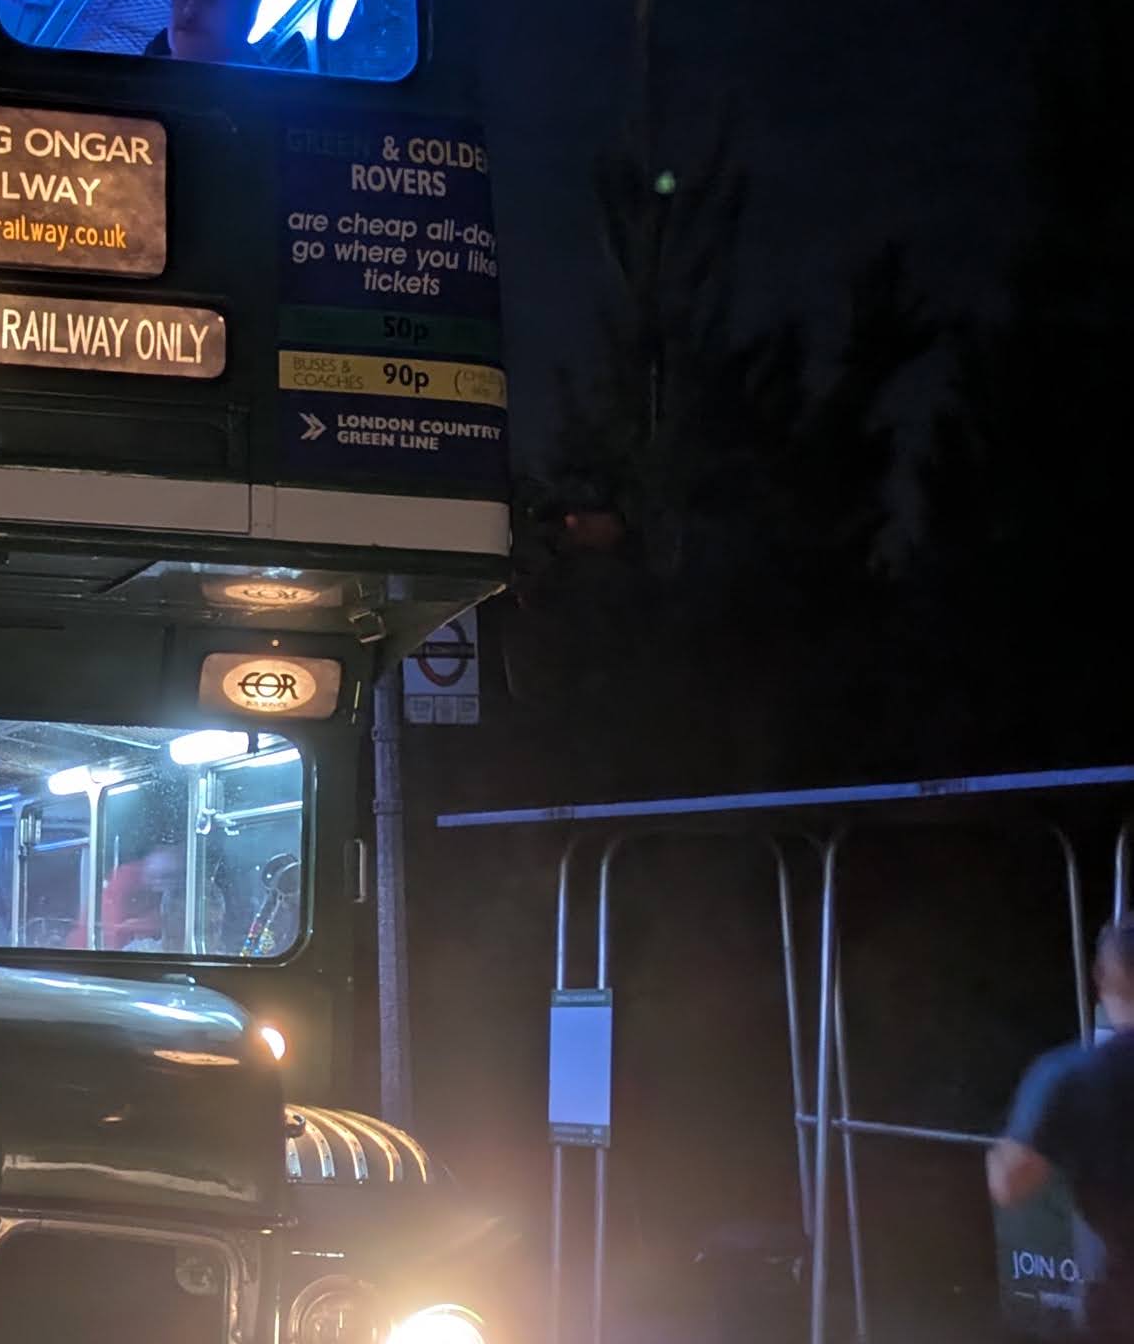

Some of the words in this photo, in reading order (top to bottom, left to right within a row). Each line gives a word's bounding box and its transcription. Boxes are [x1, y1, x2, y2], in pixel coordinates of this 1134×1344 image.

[25, 128, 152, 165] ONGAR
[382, 135, 400, 161] &
[351, 163, 447, 198] ROVERS
[288, 212, 329, 232] are
[337, 212, 418, 242] cheap
[291, 240, 325, 264] go
[334, 240, 408, 265] where
[416, 250, 459, 271] you
[467, 250, 498, 278] like
[363, 268, 442, 296] tickets
[2, 308, 129, 357] RAILWAY
[136, 319, 209, 364] ONLY
[383, 315, 429, 345] 50p
[293, 357, 337, 373] BUSES
[383, 363, 429, 393] 90p
[293, 373, 364, 391] COACHES
[336, 430, 395, 447] GREEN
[400, 436, 440, 451] LINE
[337, 414, 414, 432] LONDON
[419, 419, 502, 441] COUNTRY
[237, 671, 299, 700] EOR
